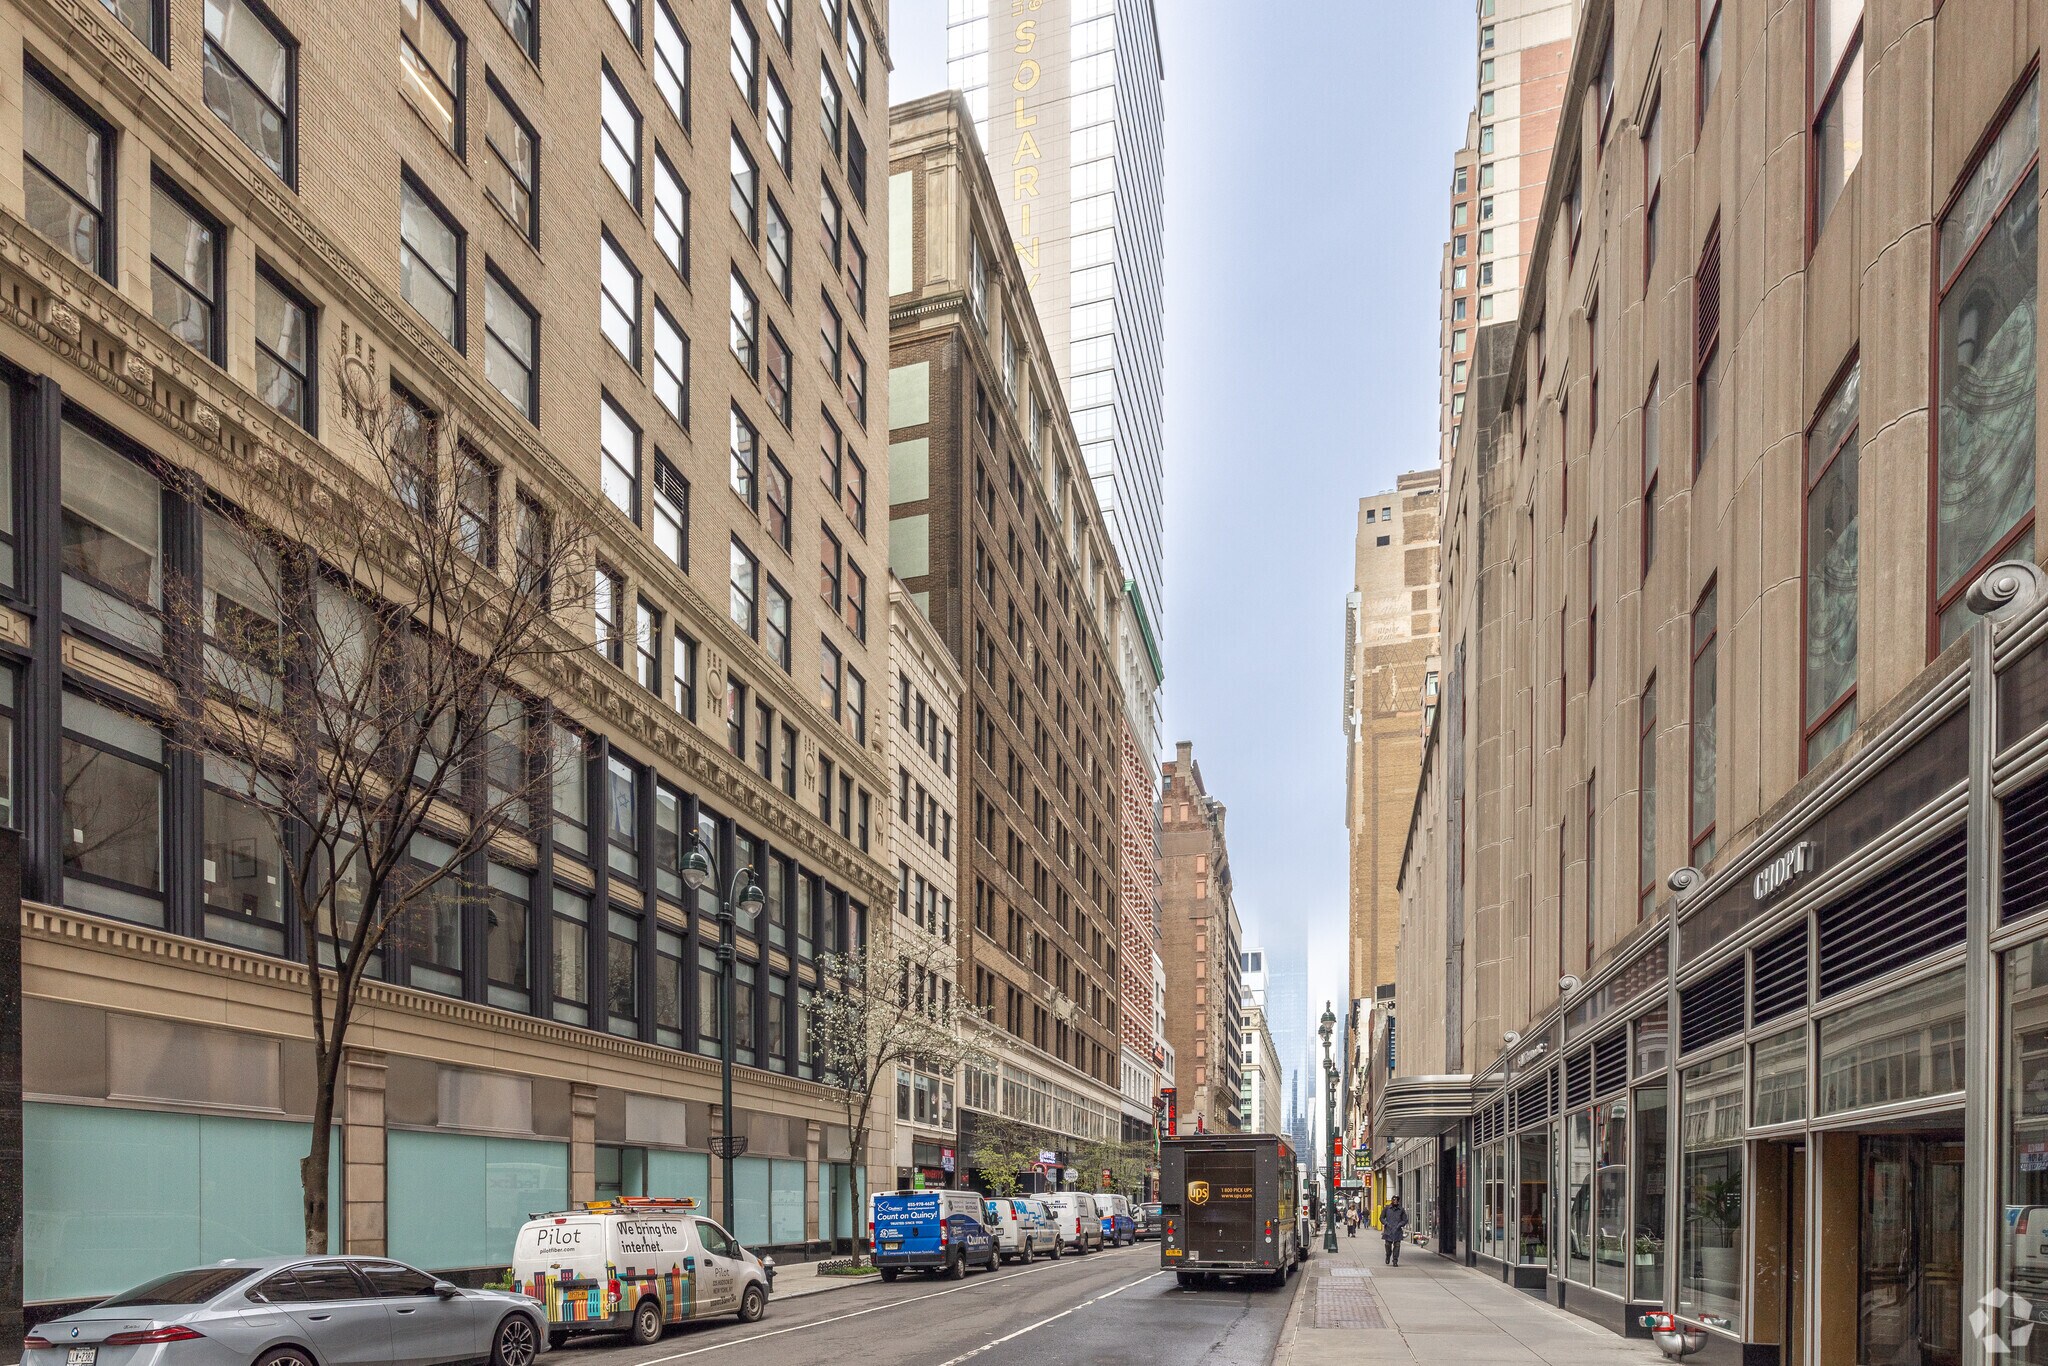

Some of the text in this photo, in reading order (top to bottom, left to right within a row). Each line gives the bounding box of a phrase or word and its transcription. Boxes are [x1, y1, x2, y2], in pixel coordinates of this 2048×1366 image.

[1190, 1186, 1208, 1202] ups
[877, 1213, 899, 1221] Count
[910, 1210, 938, 1220] Quincy!
[617, 1222, 677, 1237] We bring the
[537, 1228, 581, 1247] Pilot
[539, 1247, 575, 1255] pilotfiber.com
[621, 1240, 664, 1253] internet.
[715, 1267, 730, 1277] Pilot
